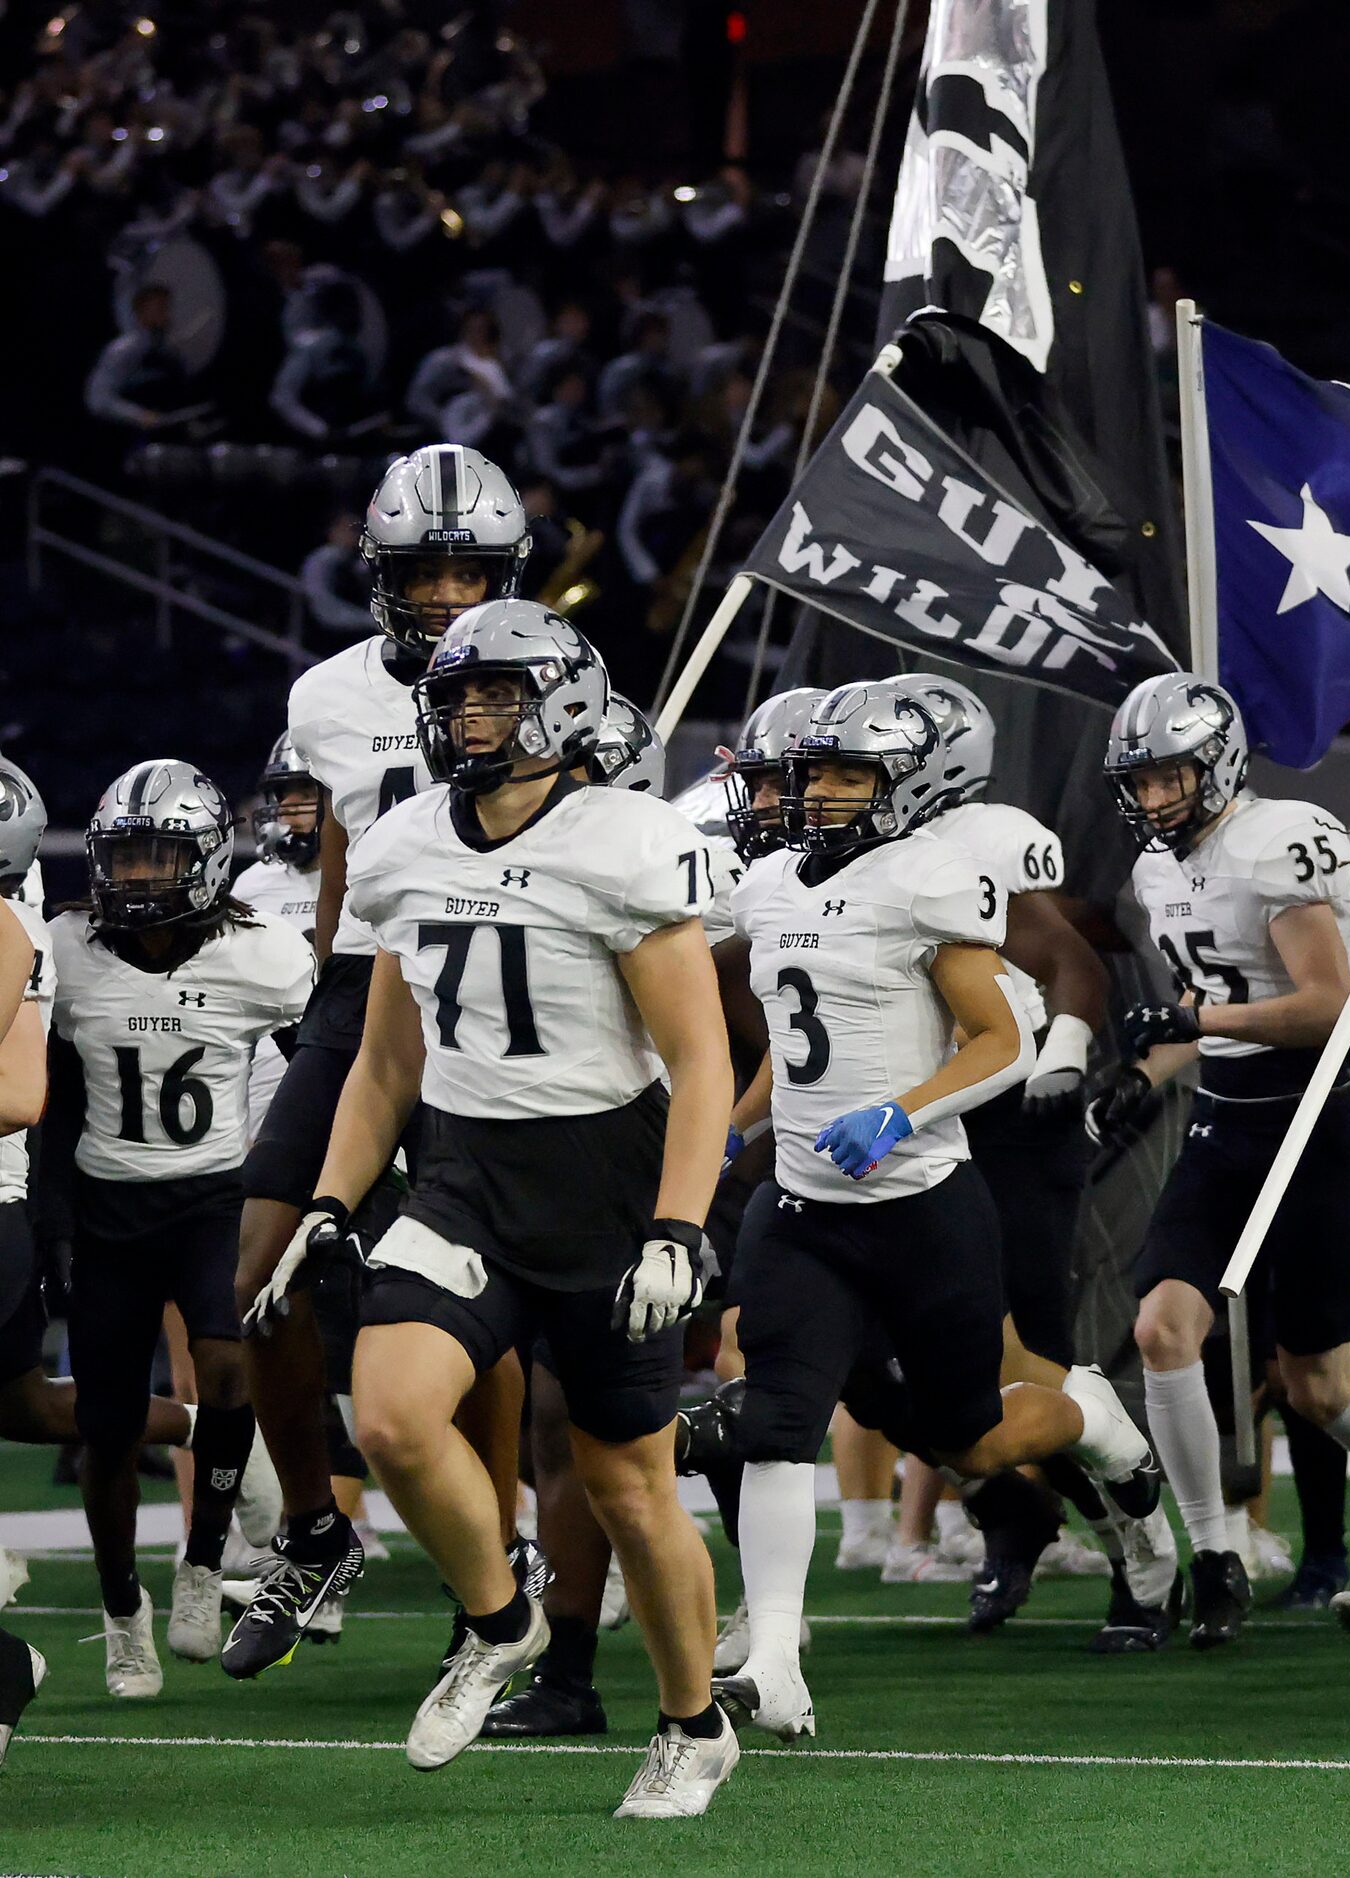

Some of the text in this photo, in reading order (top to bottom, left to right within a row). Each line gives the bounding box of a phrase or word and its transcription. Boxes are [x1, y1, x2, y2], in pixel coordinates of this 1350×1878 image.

[428, 531, 471, 541] WILDCATS
[677, 848, 715, 906] 7
[1023, 843, 1057, 881] 66
[1287, 835, 1338, 884] 35
[446, 897, 500, 917] GUYER
[978, 875, 997, 920] 3
[1165, 901, 1192, 918] GUYER
[779, 932, 819, 949] GUYER
[417, 923, 549, 1059] 71
[128, 1017, 182, 1032] GUYER
[776, 967, 831, 1085] 3
[113, 1046, 213, 1146] 16
